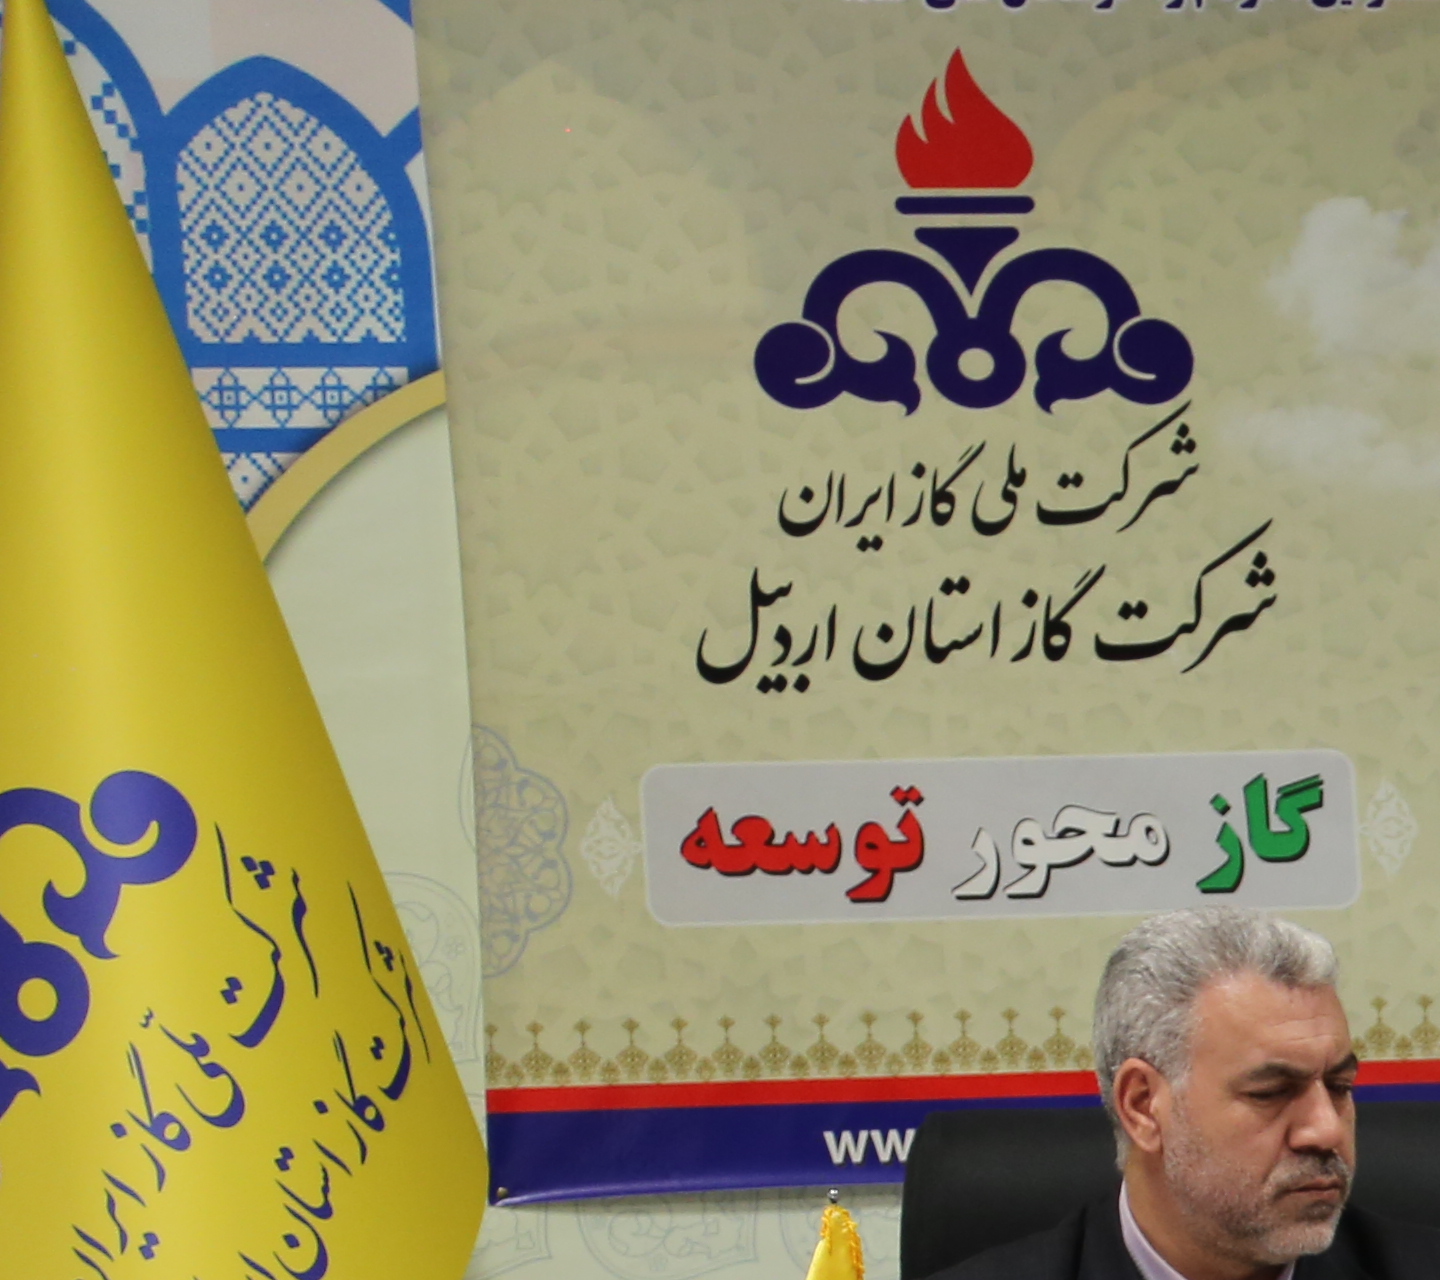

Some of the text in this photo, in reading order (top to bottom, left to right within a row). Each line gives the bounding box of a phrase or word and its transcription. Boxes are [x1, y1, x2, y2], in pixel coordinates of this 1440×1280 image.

[777, 400, 1200, 552] شرکت ملی گاز ایران
[695, 518, 1278, 695] شرکت گاز استان اردبیل
[679, 773, 1324, 904] گاز محور توسعه
[214, 821, 319, 1048] شرکت
[347, 880, 432, 1102] شرکت
[110, 1041, 192, 1193] گاز
[313, 1029, 386, 1165] گاز
